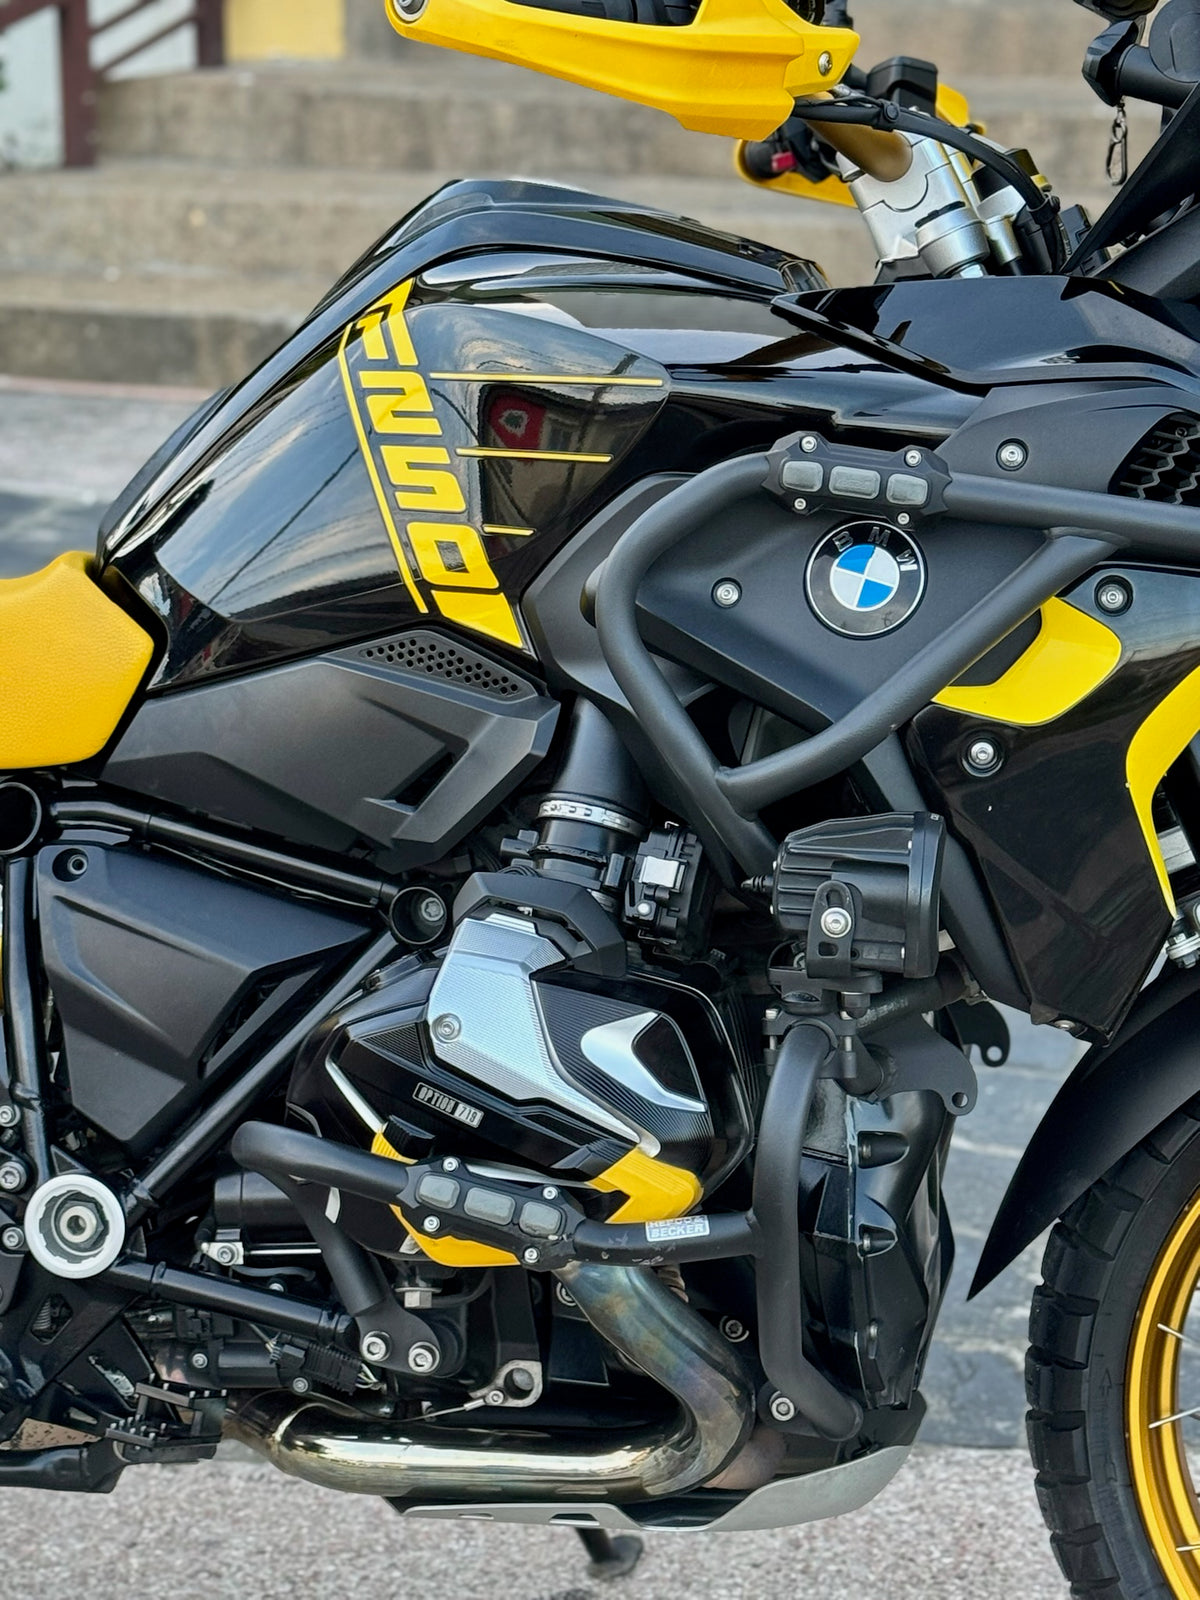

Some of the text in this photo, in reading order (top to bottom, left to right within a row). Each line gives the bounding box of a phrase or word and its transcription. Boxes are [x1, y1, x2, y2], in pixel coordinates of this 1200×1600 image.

[832, 526, 918, 571] BMW
[418, 1086, 478, 1123] OPTION 719
[651, 1223, 704, 1238] BECKER
